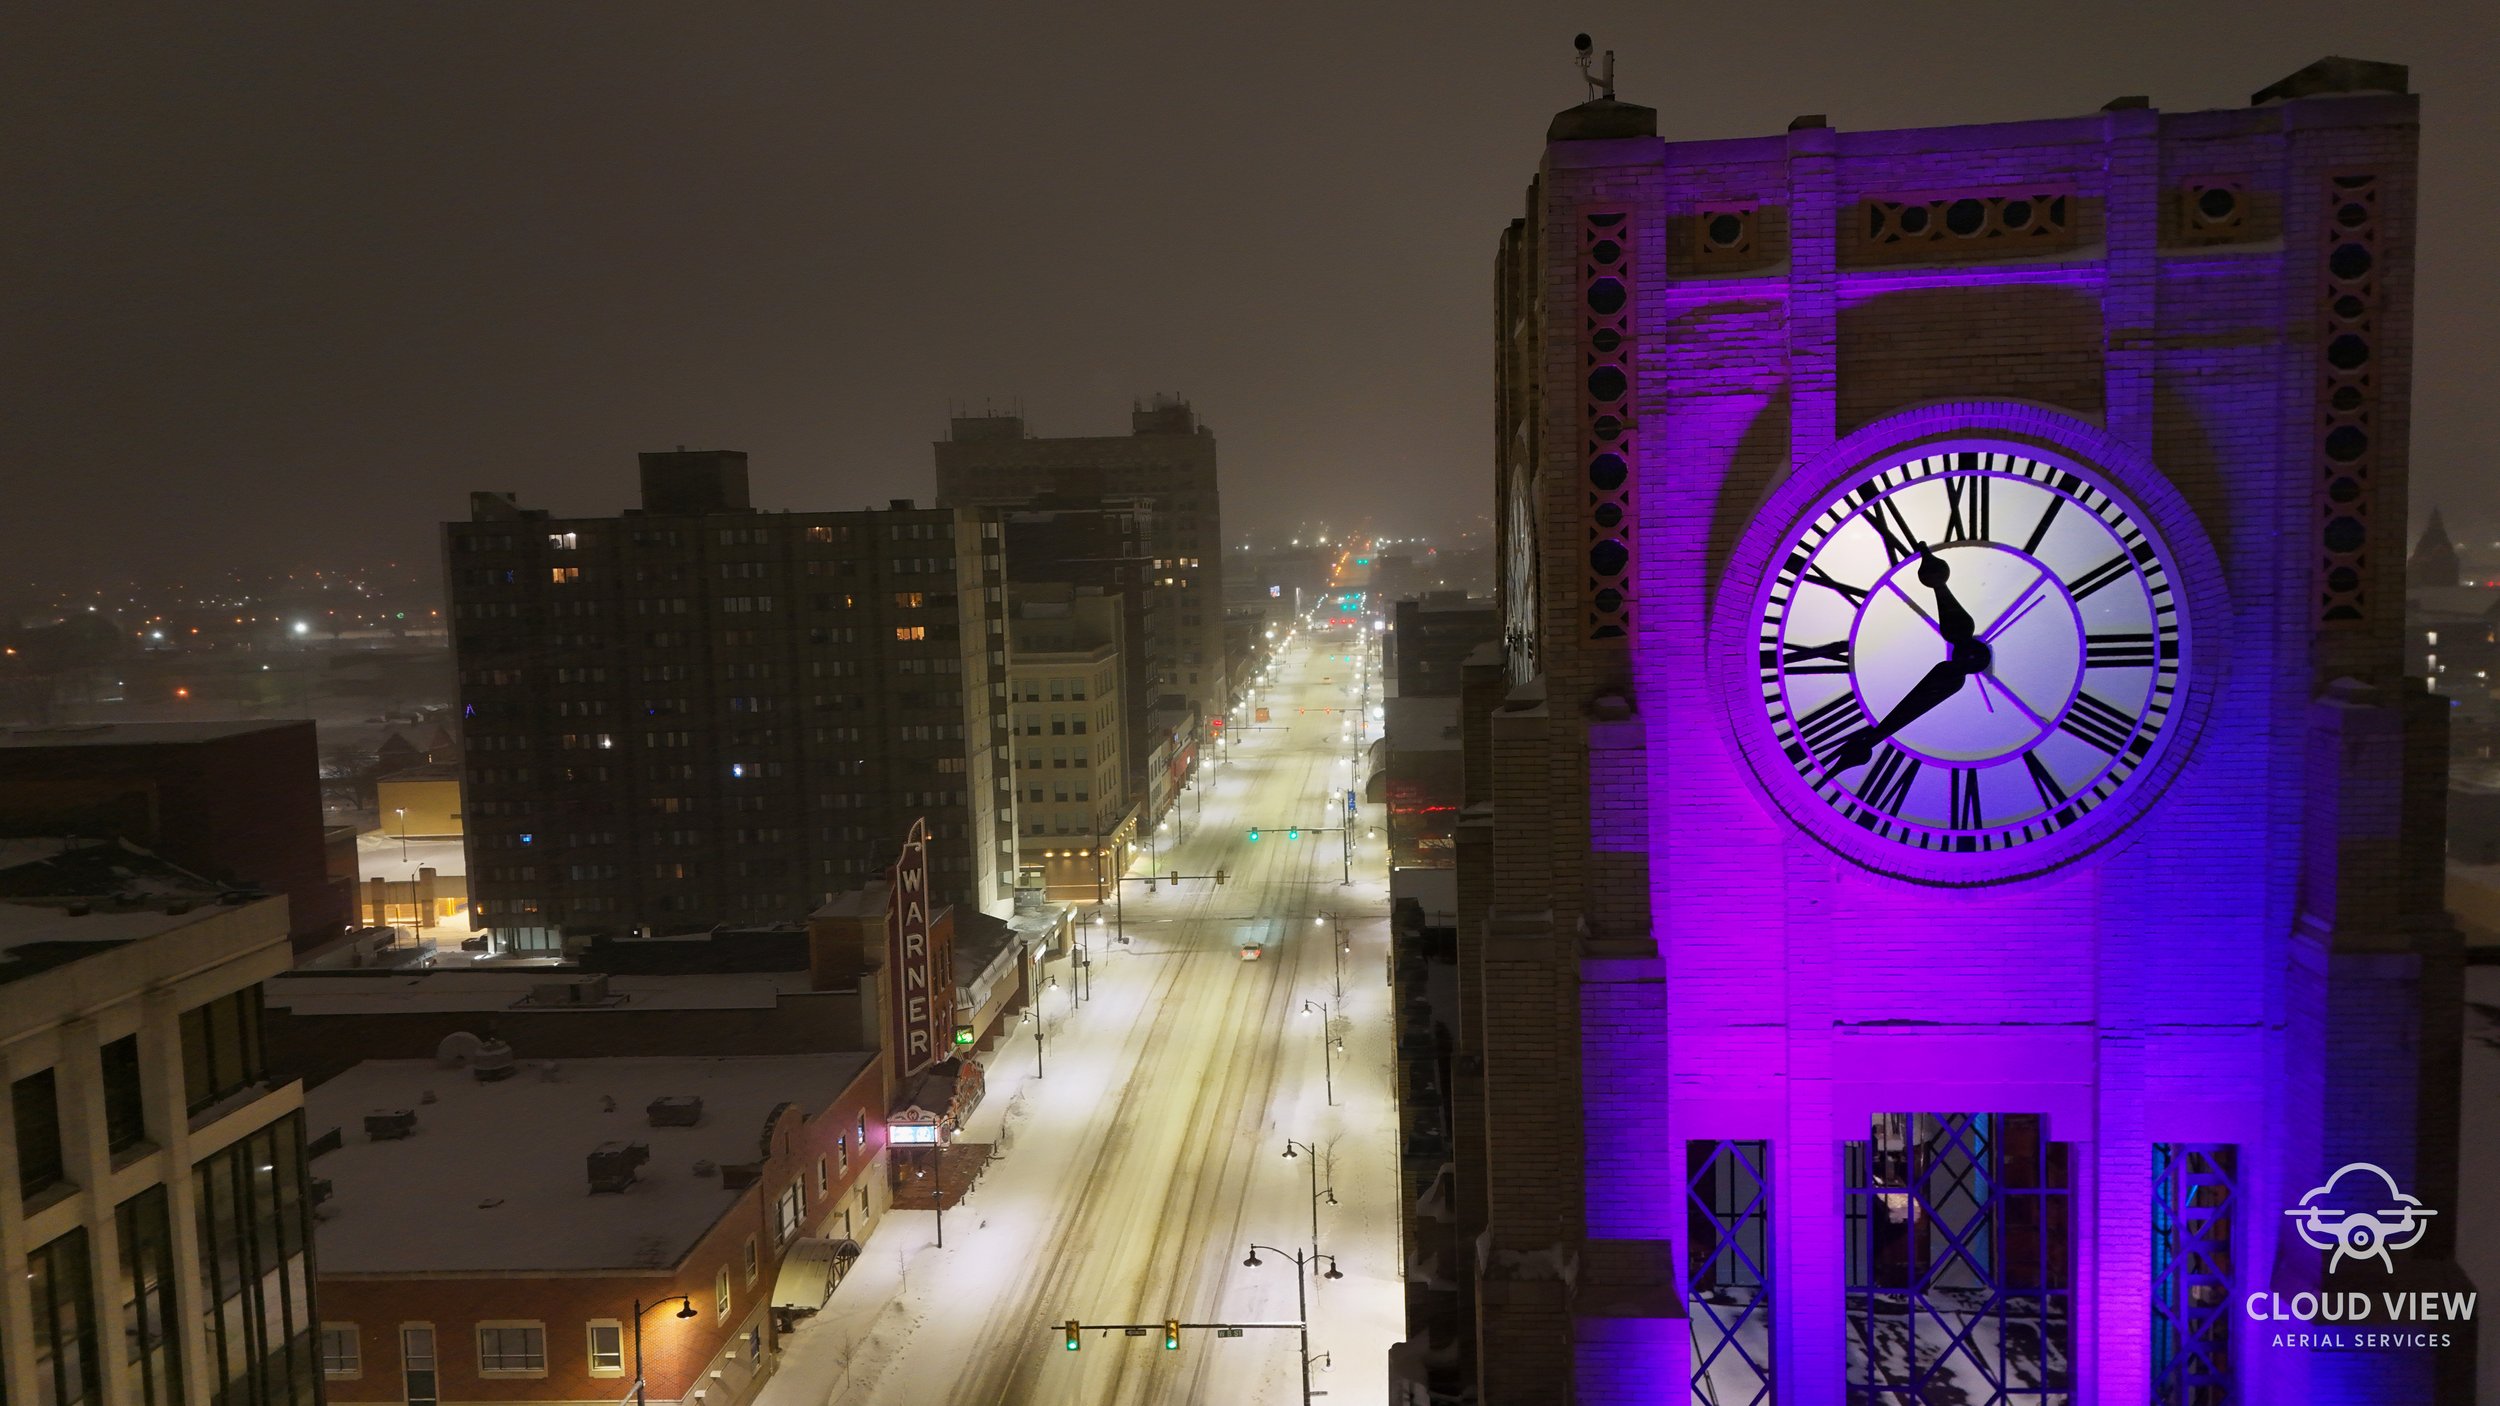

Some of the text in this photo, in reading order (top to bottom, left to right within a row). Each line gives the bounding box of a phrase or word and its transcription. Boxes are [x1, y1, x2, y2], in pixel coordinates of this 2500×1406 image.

[1861, 495, 1919, 568] XI
[1945, 475, 1990, 543] XII
[2022, 495, 2065, 556] I
[1803, 563, 1869, 608] X
[2066, 553, 2133, 603] II
[1783, 640, 1850, 675] IX
[2085, 633, 2154, 669] III
[1857, 746, 1922, 817] VII
[1949, 767, 1982, 830] VI
[2021, 750, 2070, 811] V
[902, 868, 928, 1057] WARNER
